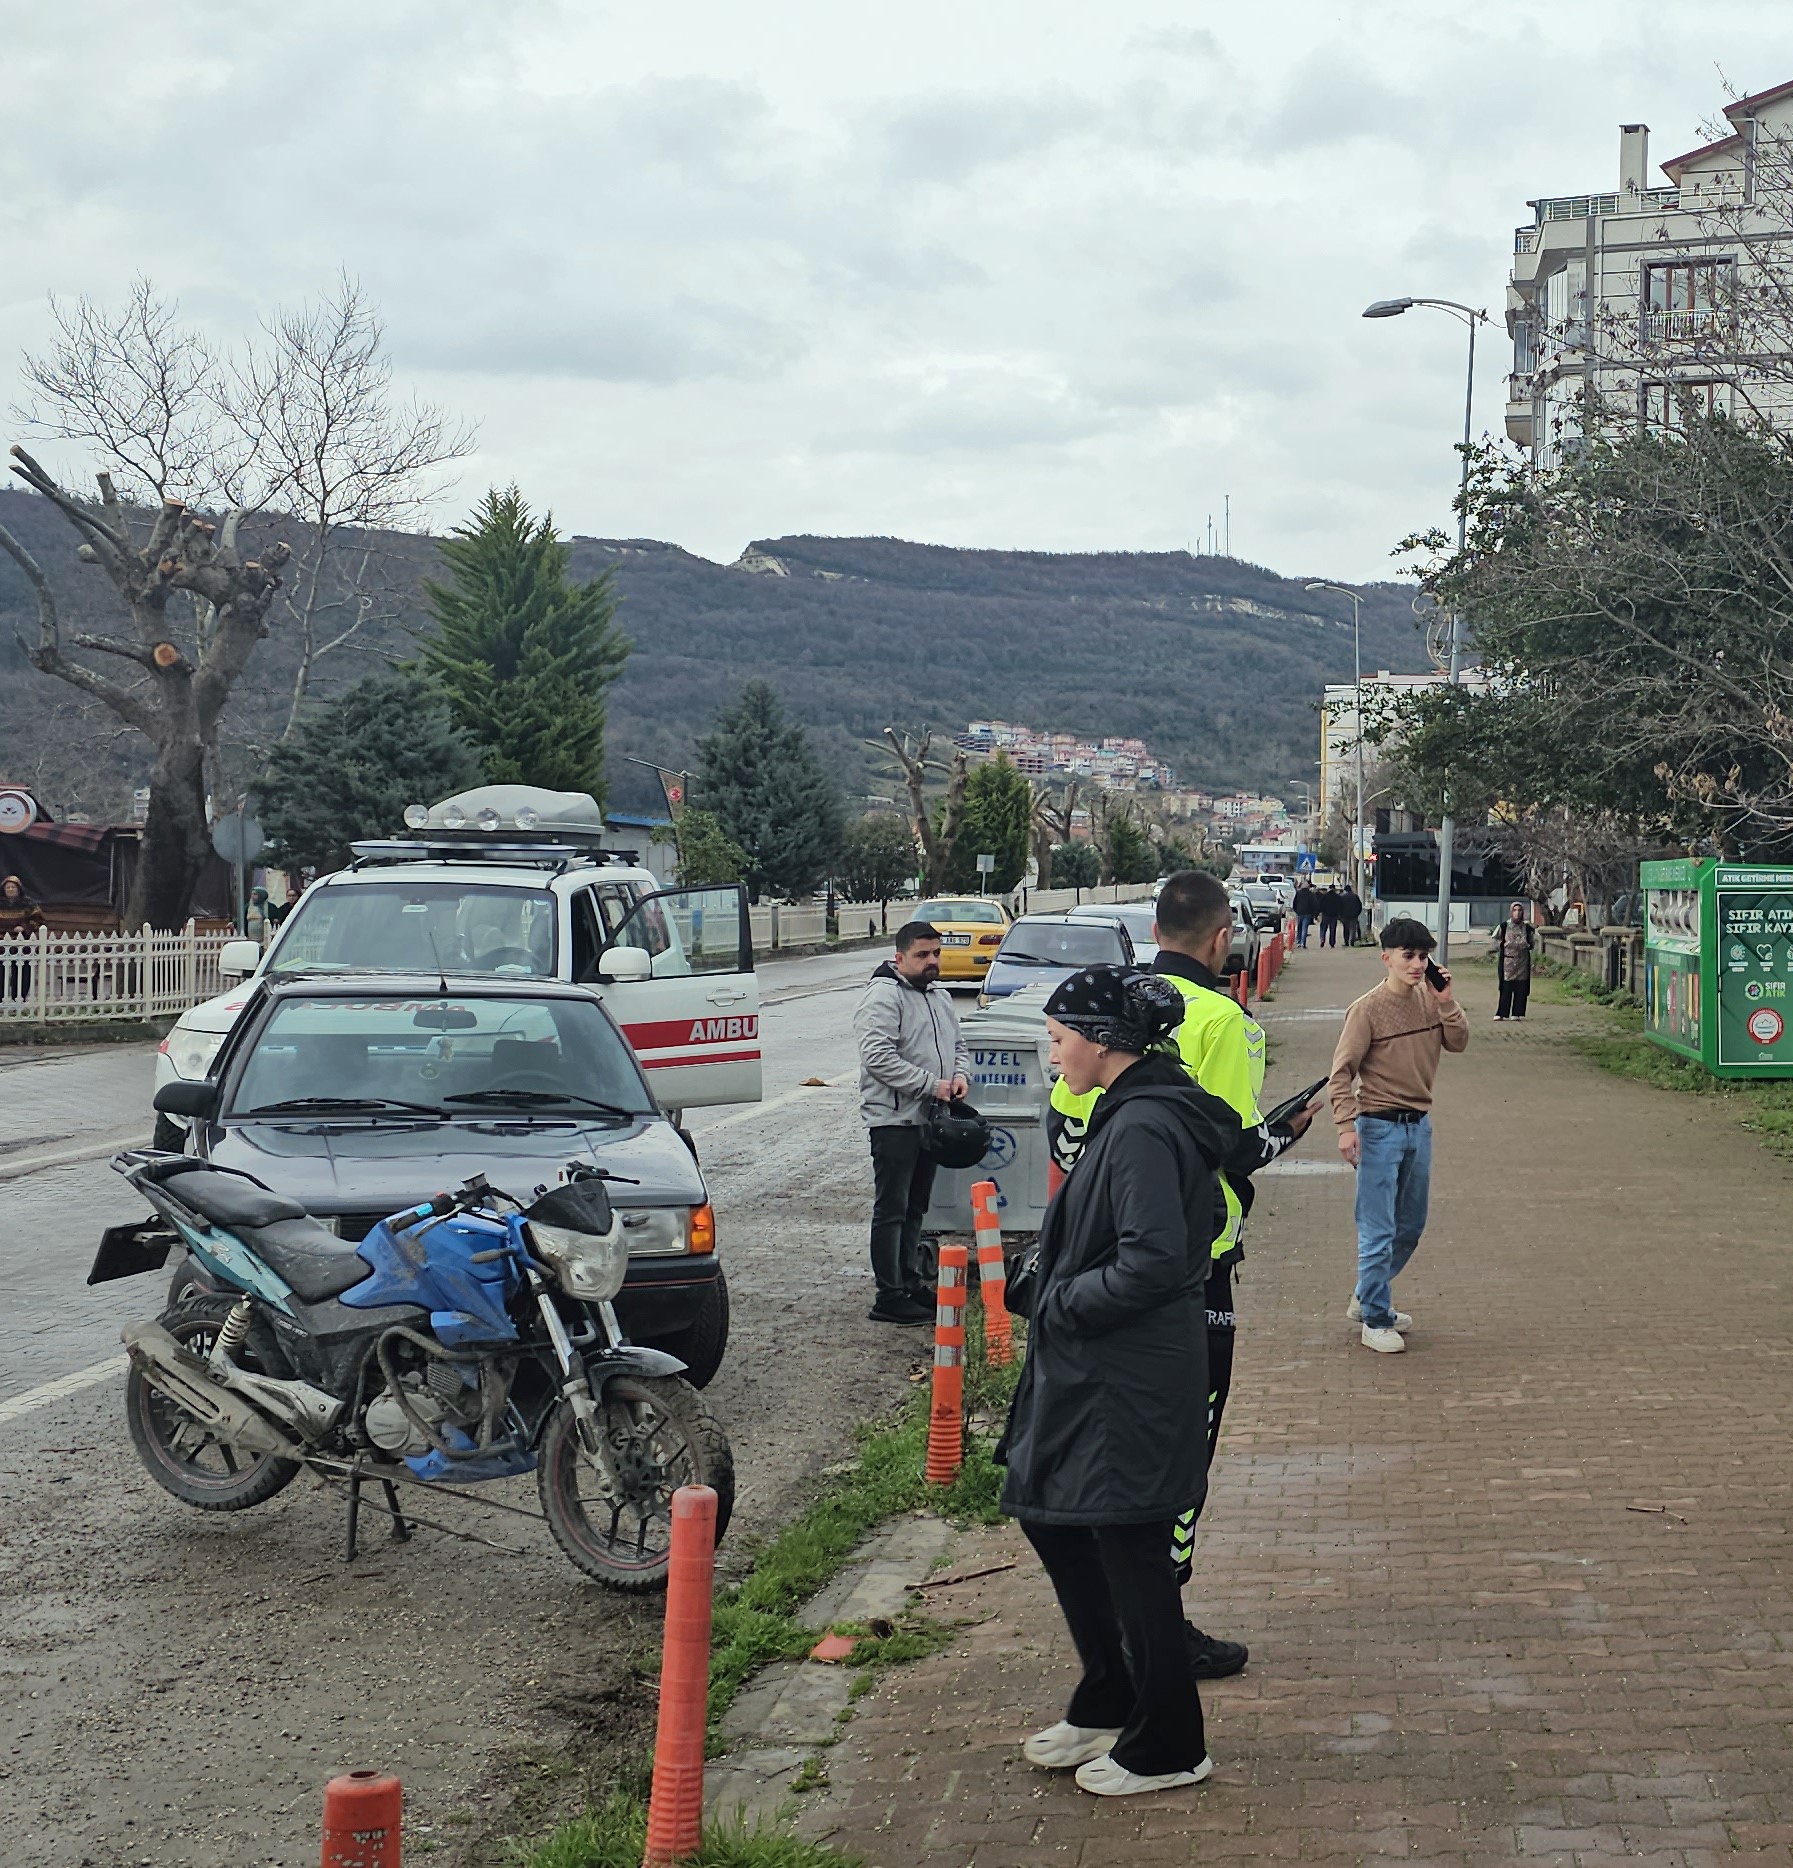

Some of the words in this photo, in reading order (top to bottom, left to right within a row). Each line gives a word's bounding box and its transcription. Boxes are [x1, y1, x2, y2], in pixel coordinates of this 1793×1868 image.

[1728, 909, 1764, 921] SIFIR
[1725, 922, 1762, 934] SIFIR
[688, 1017, 758, 1041] AMBU
[971, 1073, 1026, 1085] ONTEYNER
